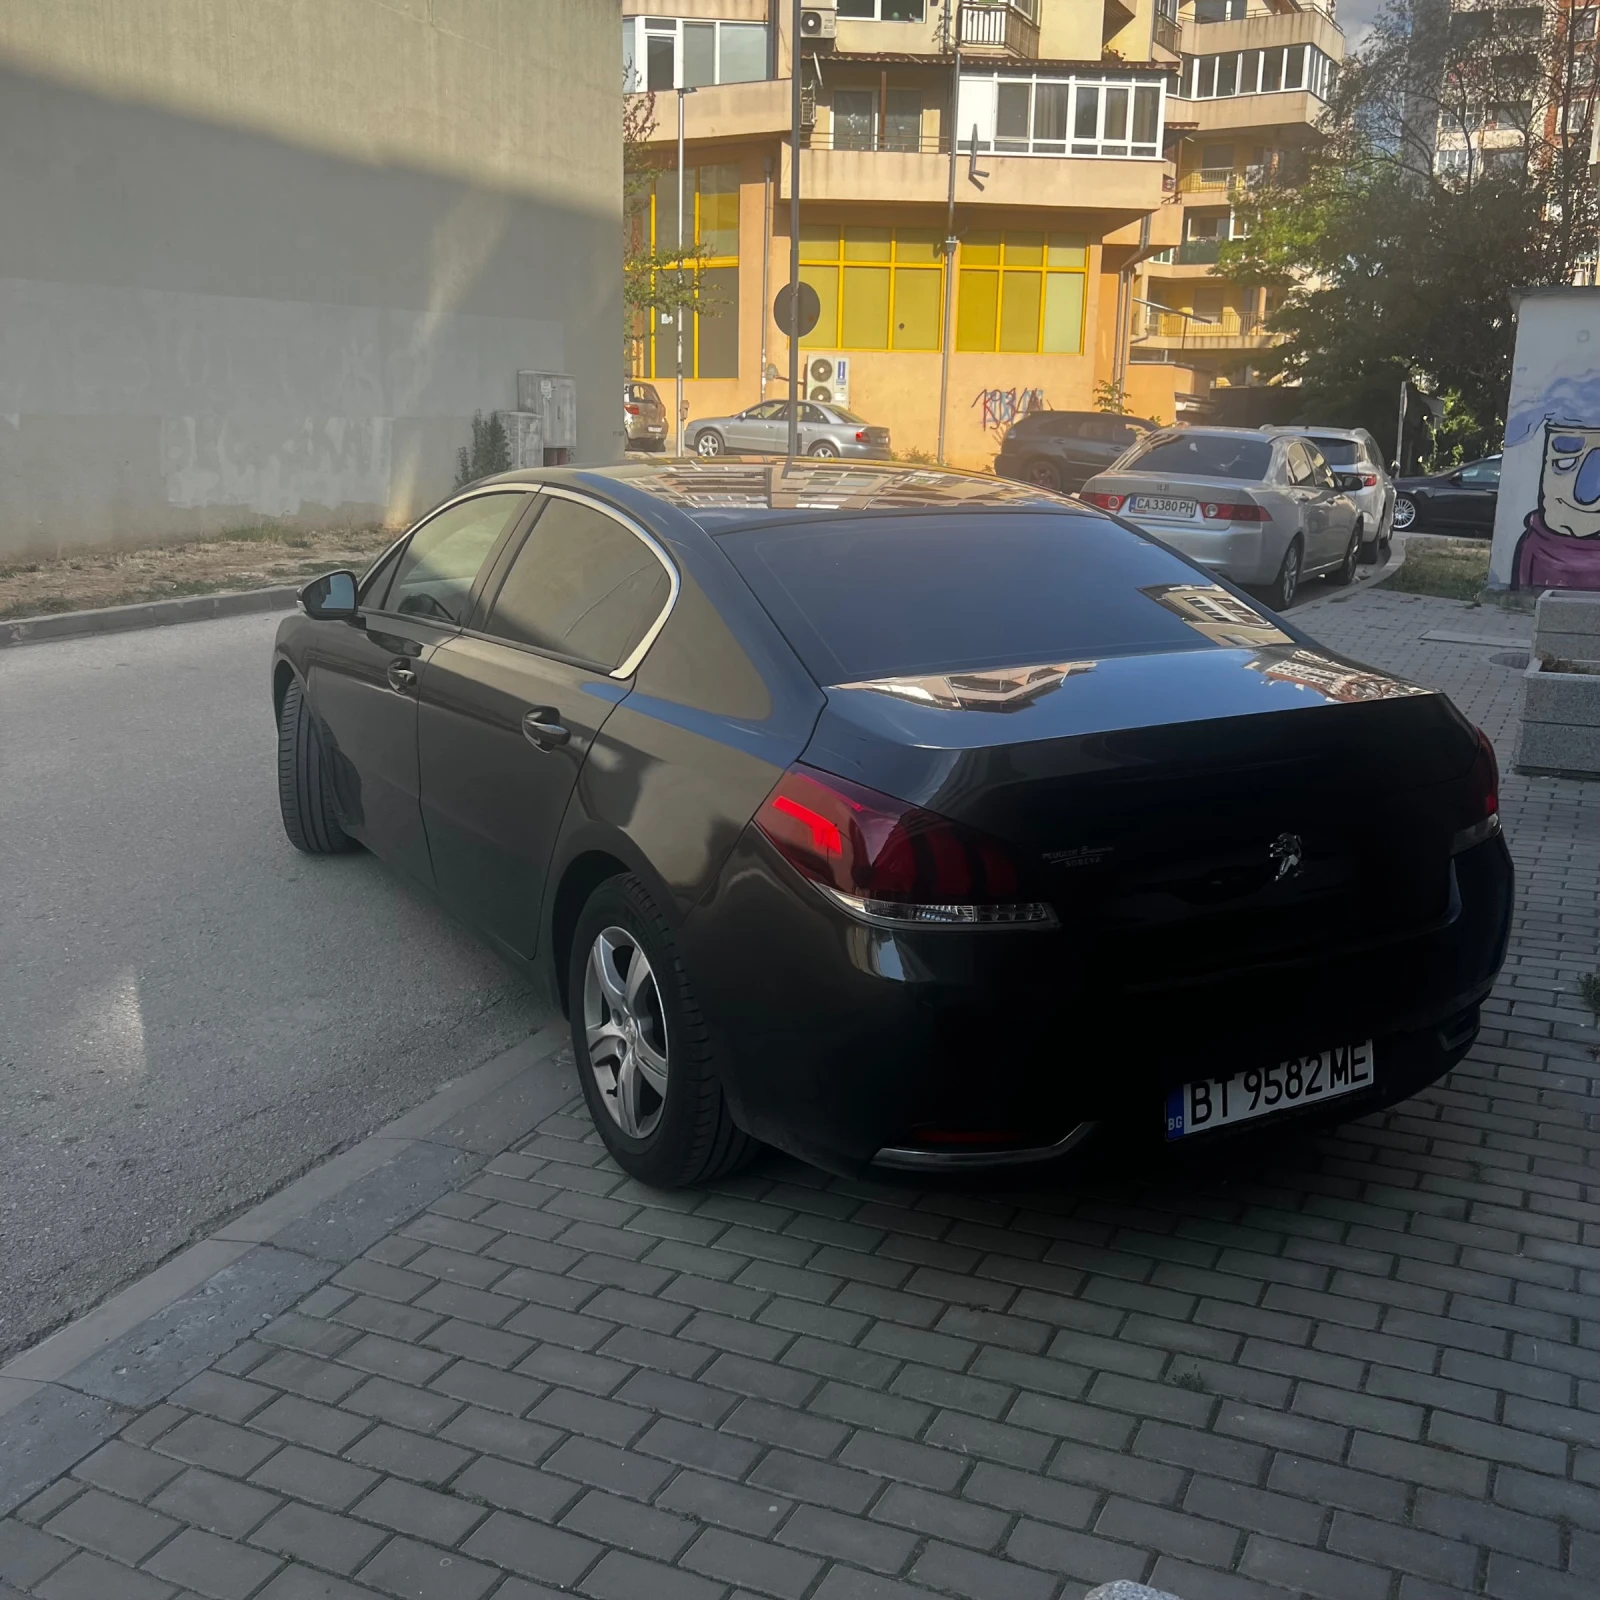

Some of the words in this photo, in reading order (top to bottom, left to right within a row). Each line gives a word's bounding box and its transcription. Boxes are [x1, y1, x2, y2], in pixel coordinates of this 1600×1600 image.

[1137, 498, 1150, 510] CA
[1152, 499, 1178, 512] 3380
[1179, 501, 1194, 513] PH
[1190, 1077, 1235, 1126] BT
[1243, 1051, 1323, 1112] 9582
[1329, 1043, 1369, 1090] ME
[1167, 1115, 1183, 1131] BG
